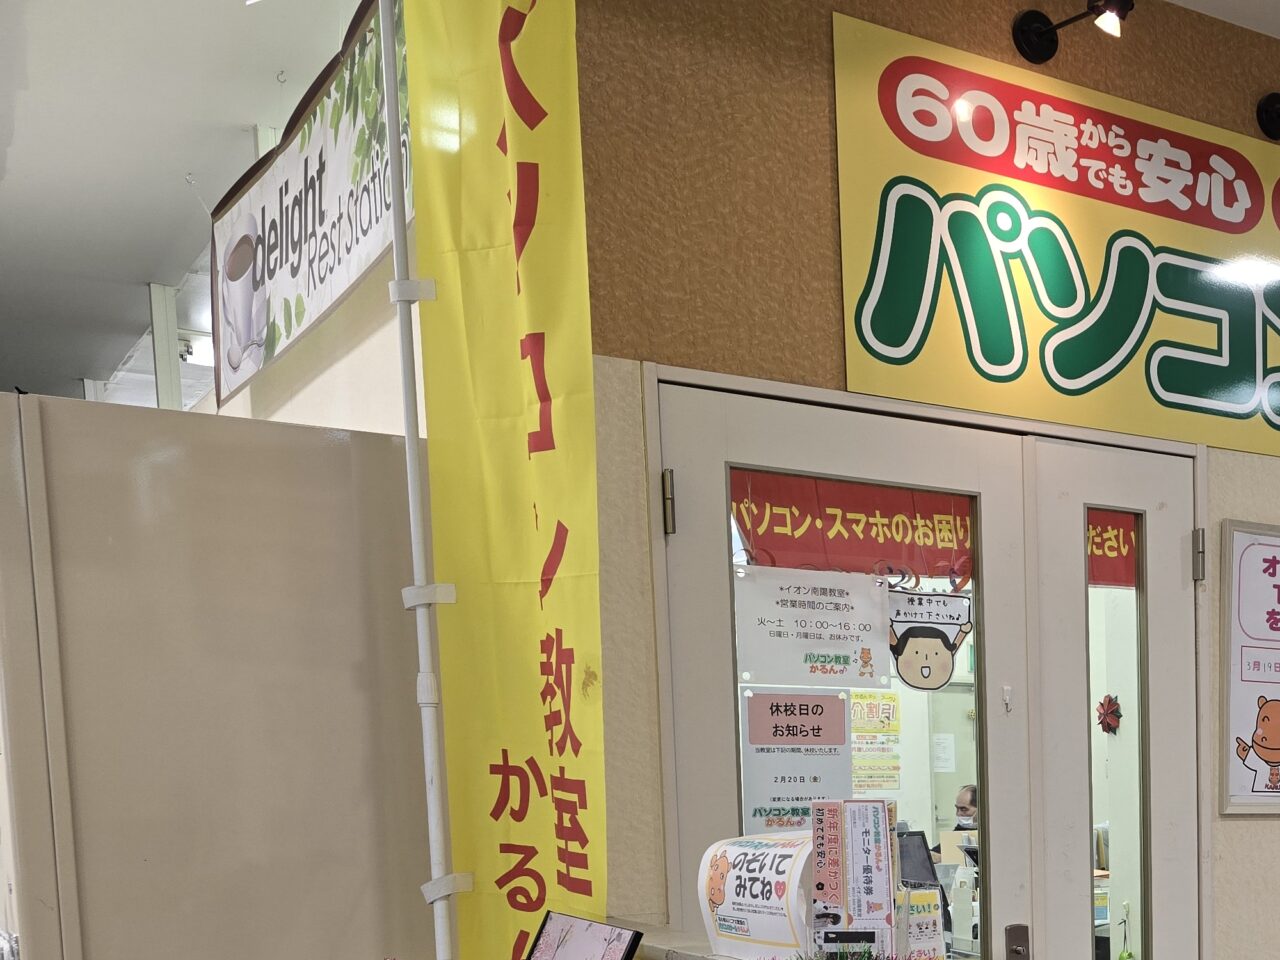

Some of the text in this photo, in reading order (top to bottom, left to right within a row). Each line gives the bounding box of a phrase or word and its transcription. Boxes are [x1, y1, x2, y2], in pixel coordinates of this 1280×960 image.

[253, 149, 328, 292] delight
[305, 208, 344, 298] Rest
[907, 597, 949, 607] 授業中でも
[804, 653, 850, 665] パソコン教室
[769, 702, 824, 717] 休校日の
[772, 723, 822, 737] お知らせ
[732, 851, 793, 875] のぞいて
[735, 875, 772, 901] みてね
